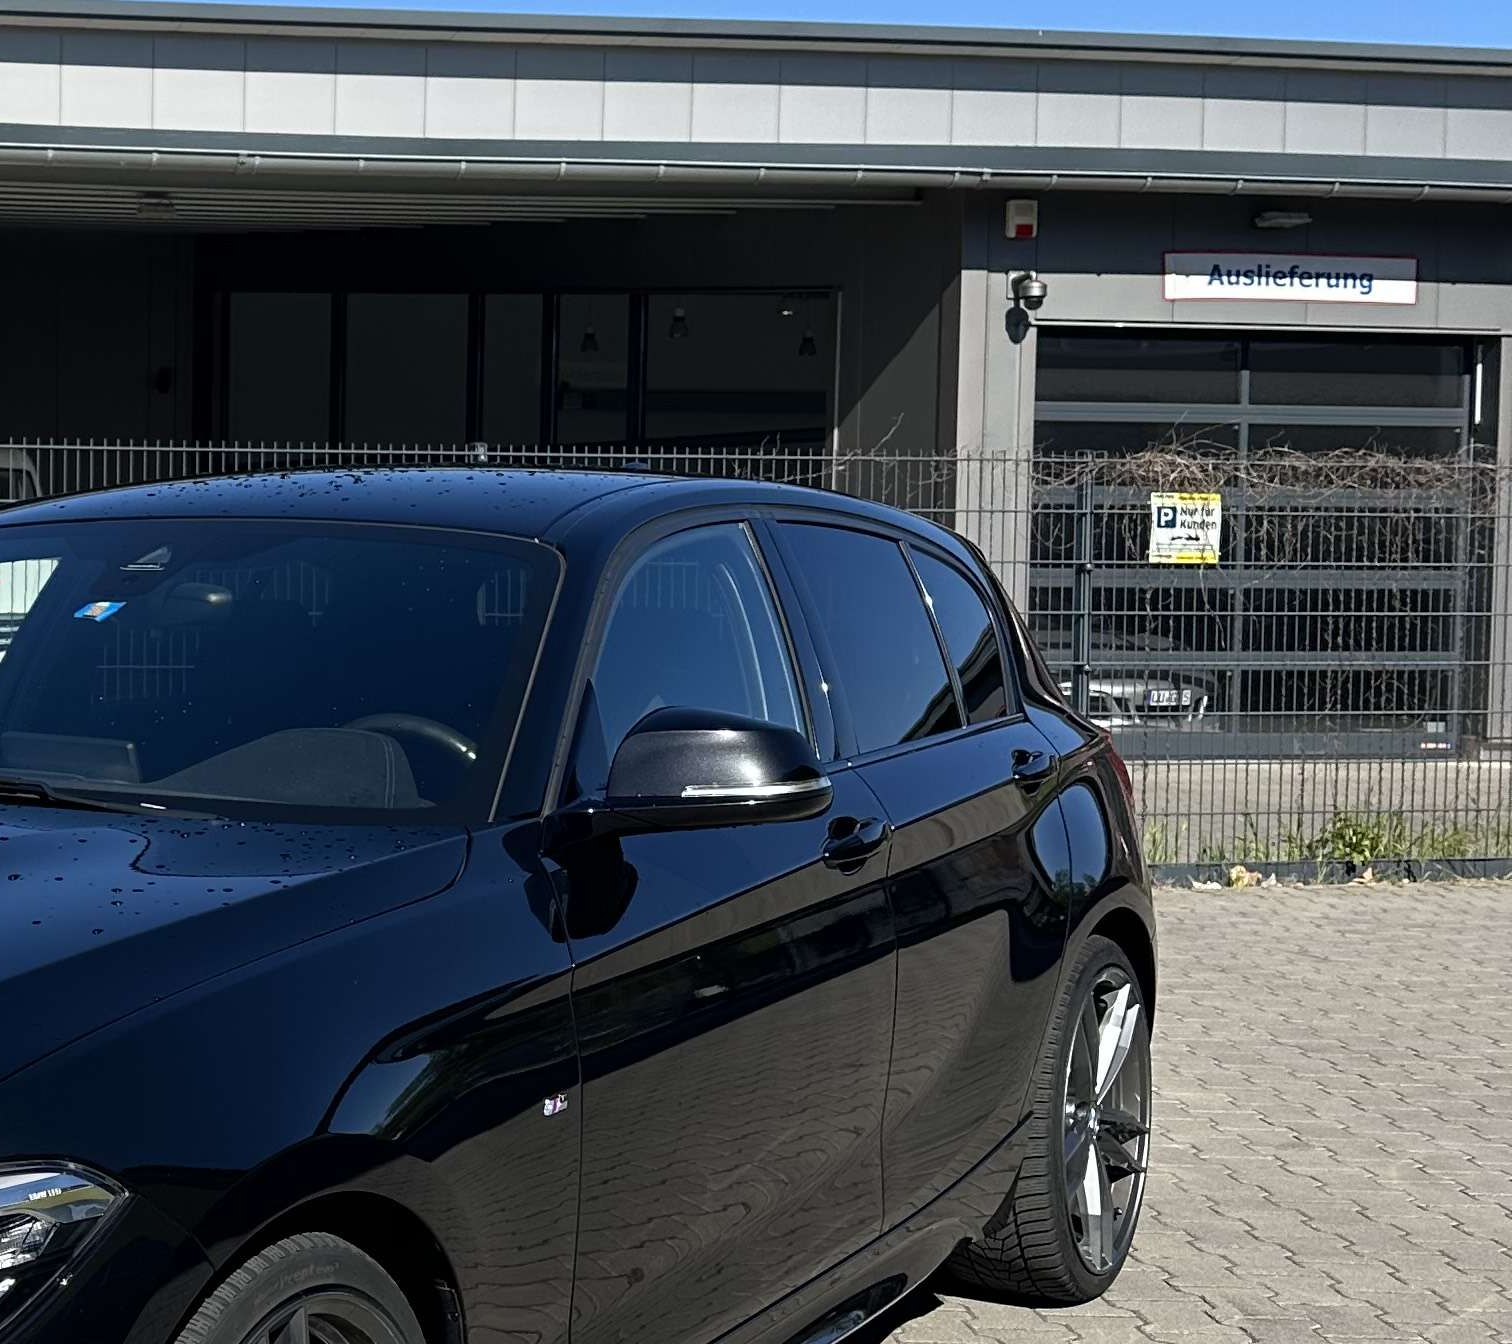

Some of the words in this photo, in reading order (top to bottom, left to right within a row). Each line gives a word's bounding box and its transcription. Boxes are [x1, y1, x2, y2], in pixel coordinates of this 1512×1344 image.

[1207, 264, 1374, 295] Auslieferung
[1180, 506, 1198, 517] Nur
[1180, 519, 1217, 530] Kunden
